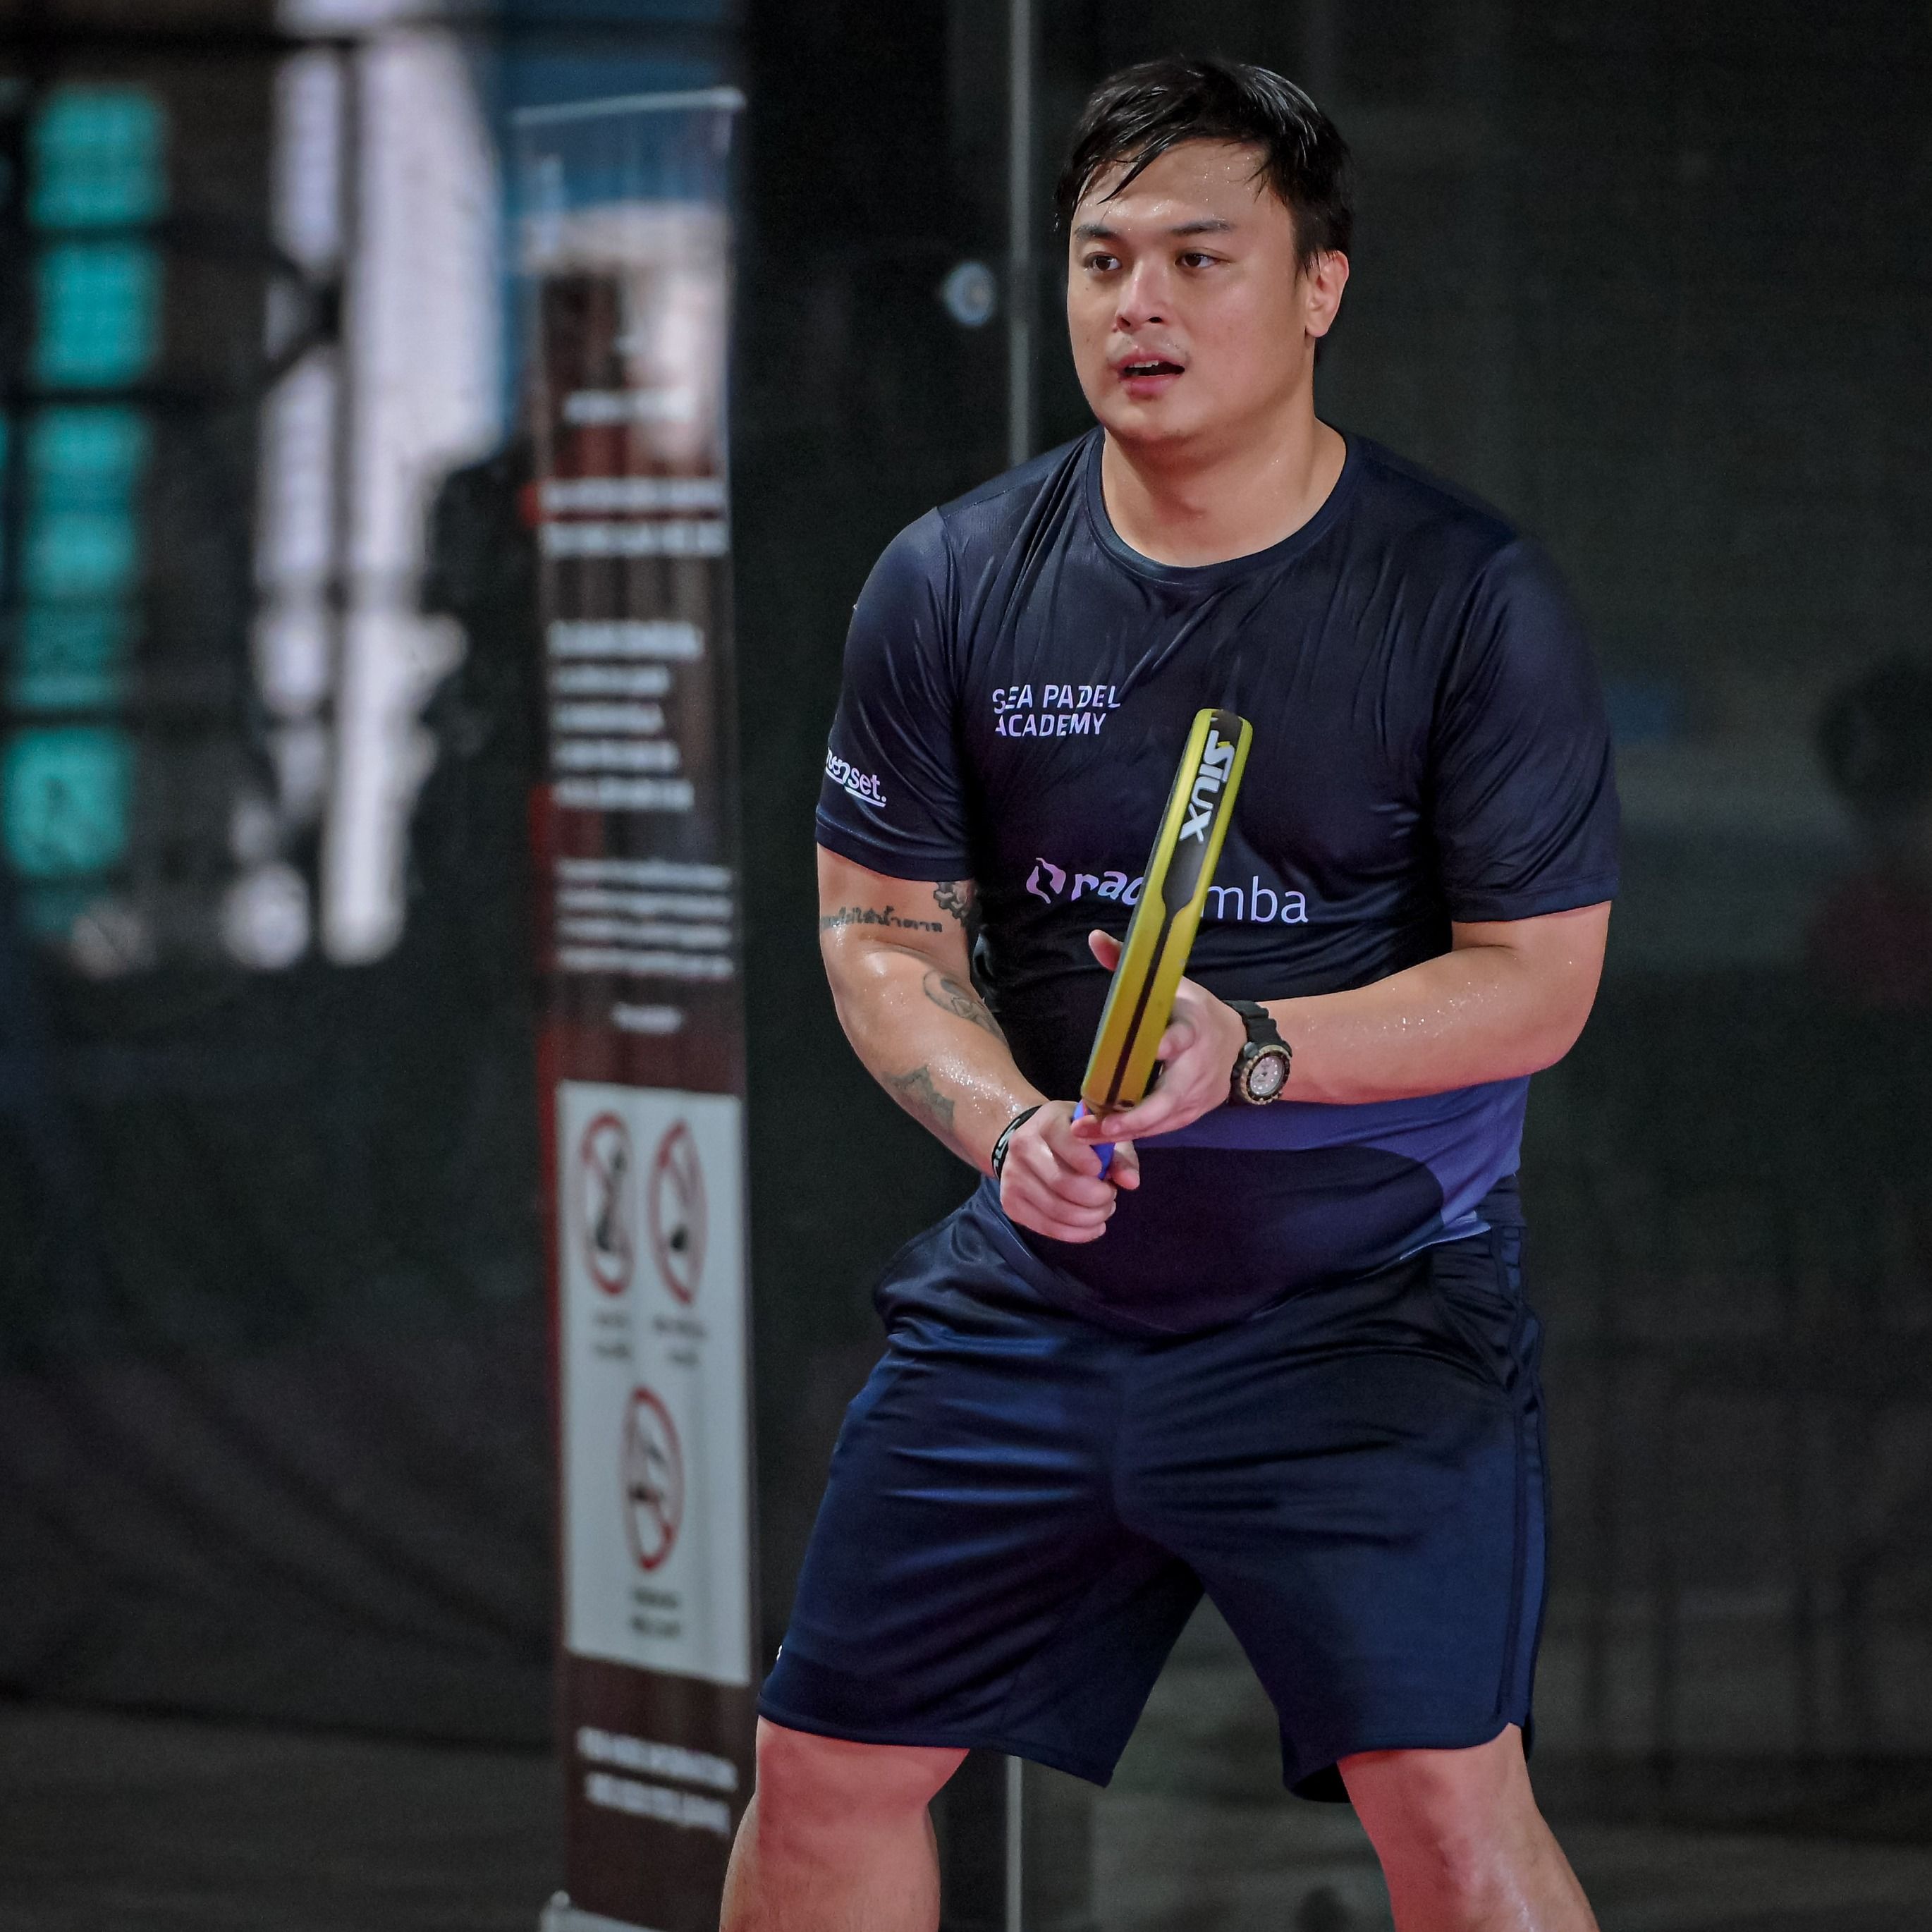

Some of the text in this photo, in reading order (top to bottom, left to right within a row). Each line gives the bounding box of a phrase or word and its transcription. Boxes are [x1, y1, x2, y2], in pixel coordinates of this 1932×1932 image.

[992, 685, 1121, 714] SEA PADEL
[995, 712, 1106, 737] ACADEMY
[1180, 730, 1235, 842] SIUX
